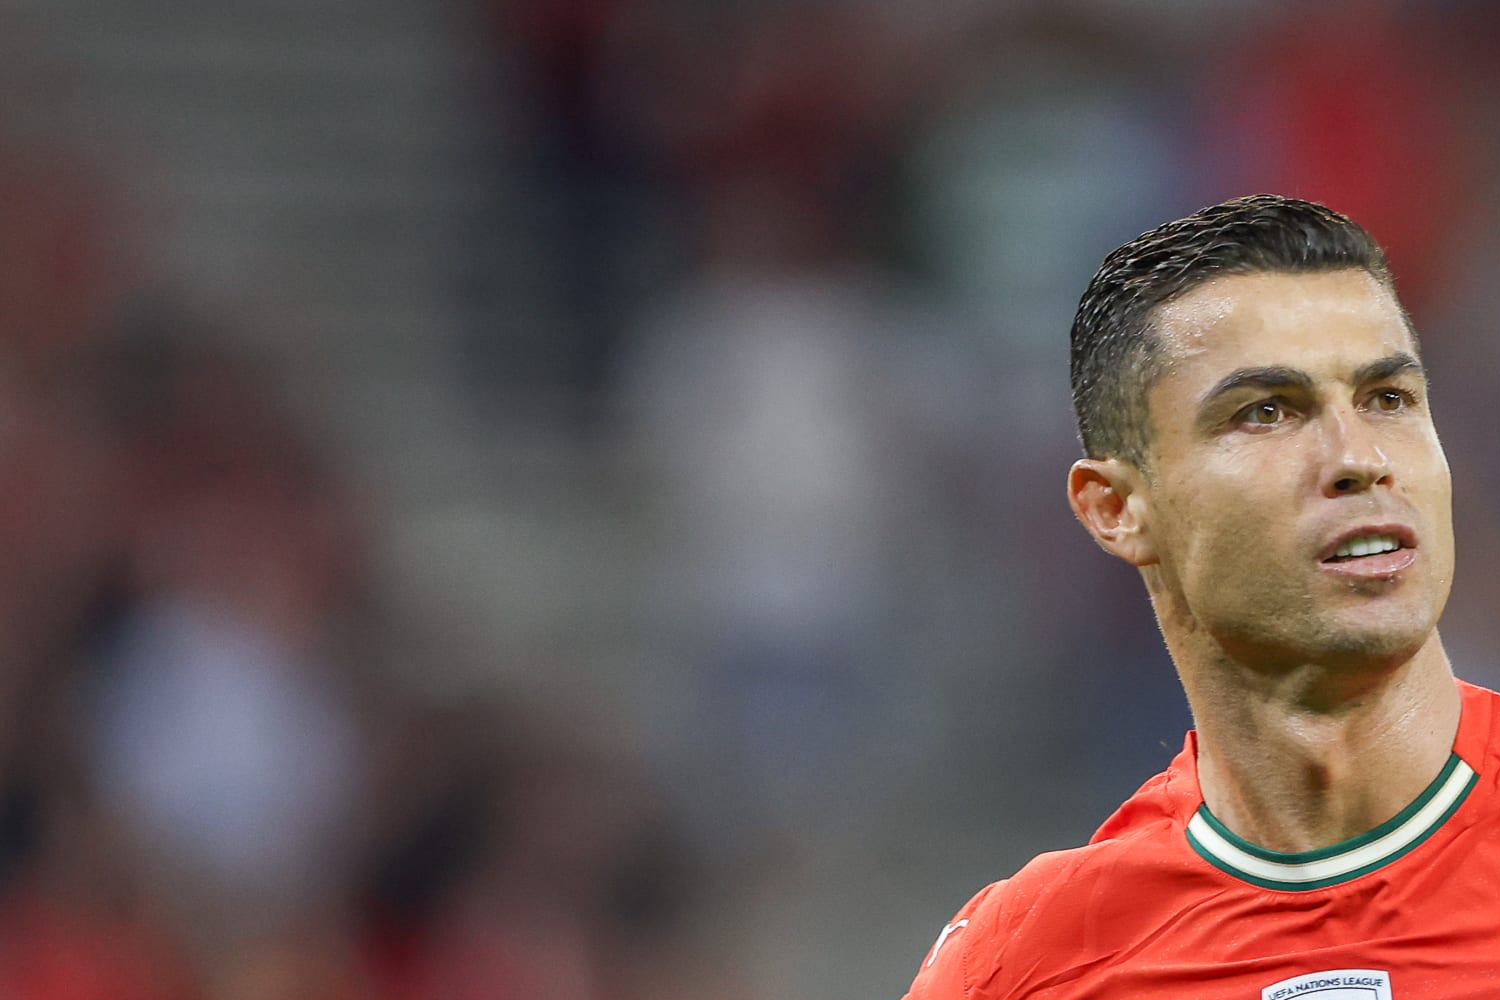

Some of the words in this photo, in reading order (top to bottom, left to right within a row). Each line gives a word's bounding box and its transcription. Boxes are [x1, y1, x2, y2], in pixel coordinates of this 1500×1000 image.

[1268, 988, 1294, 1000] UEFA
[1296, 978, 1341, 992] NATIONS
[1343, 977, 1384, 986] LEAGUE
